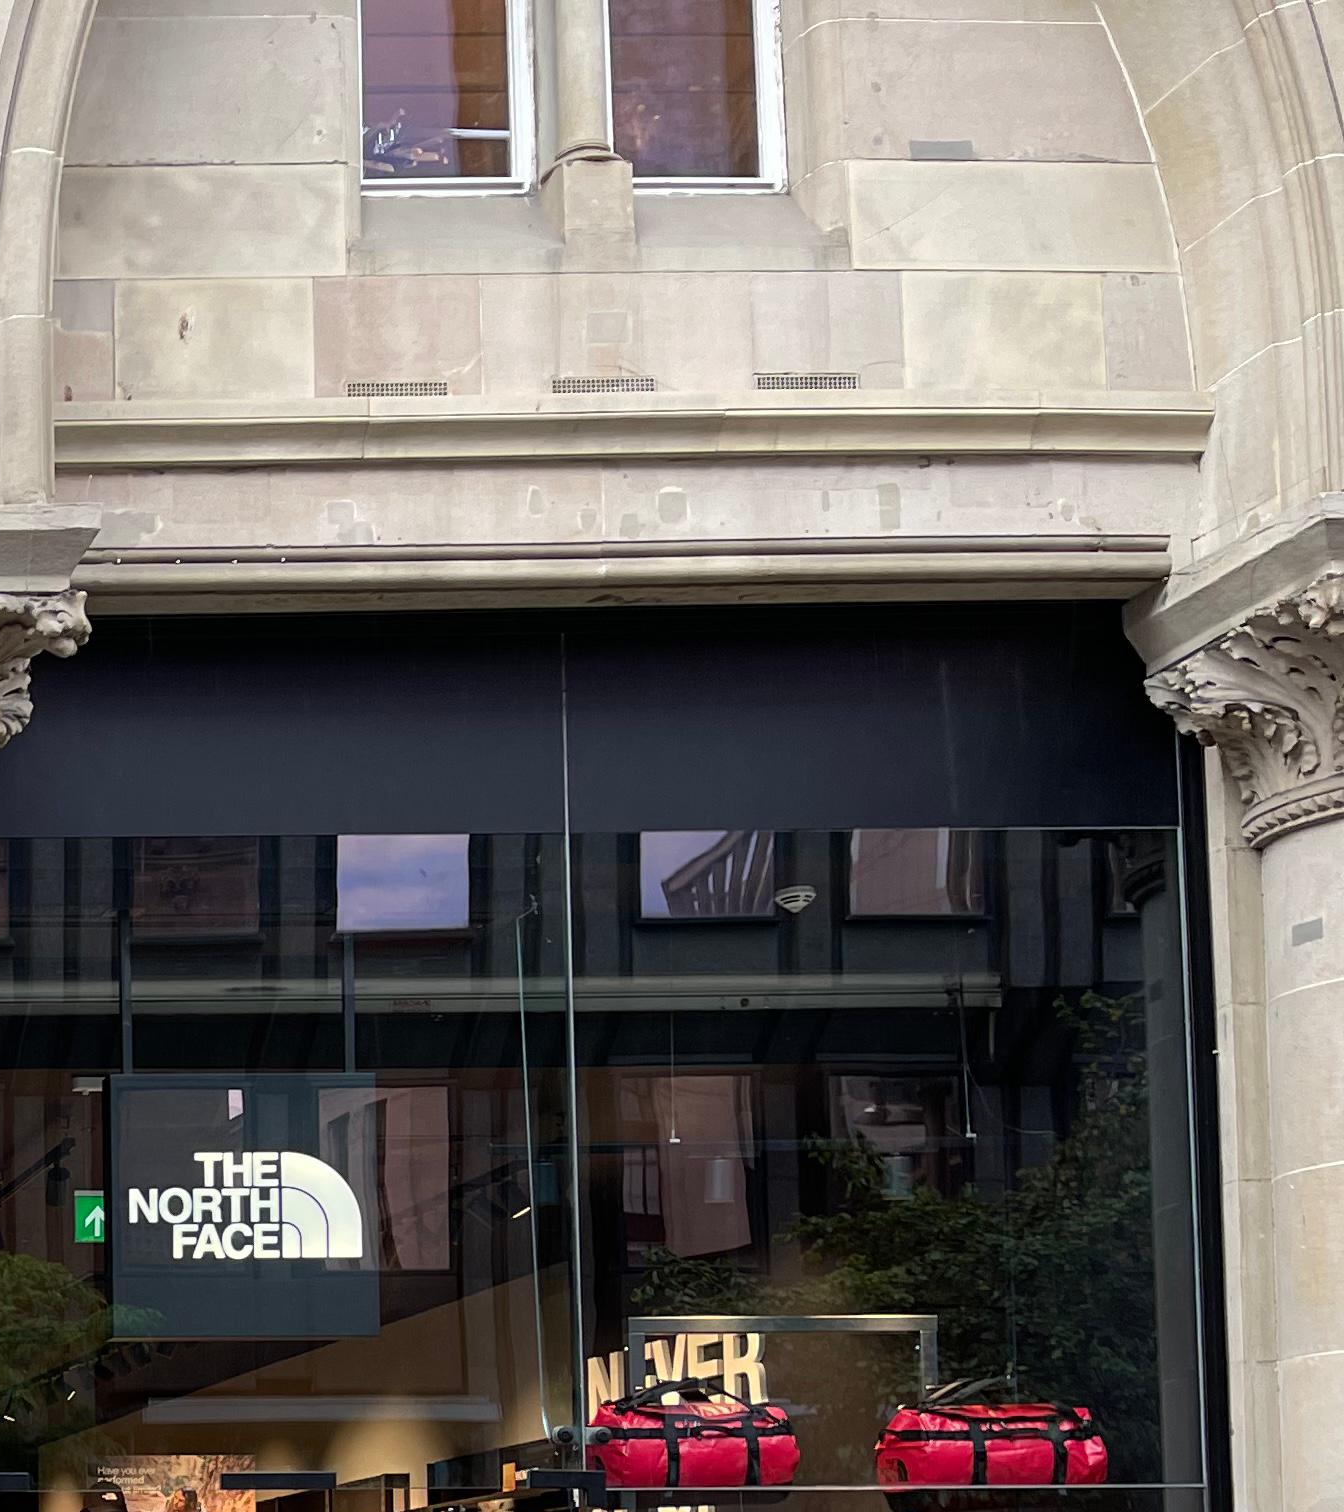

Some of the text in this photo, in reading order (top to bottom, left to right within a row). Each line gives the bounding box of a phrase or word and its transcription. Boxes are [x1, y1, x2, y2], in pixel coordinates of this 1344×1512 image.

[193, 1151, 279, 1187] THE
[128, 1187, 280, 1224] NORTH
[172, 1222, 281, 1260] FACE
[97, 1466, 119, 1475] Have
[121, 1467, 137, 1476] you
